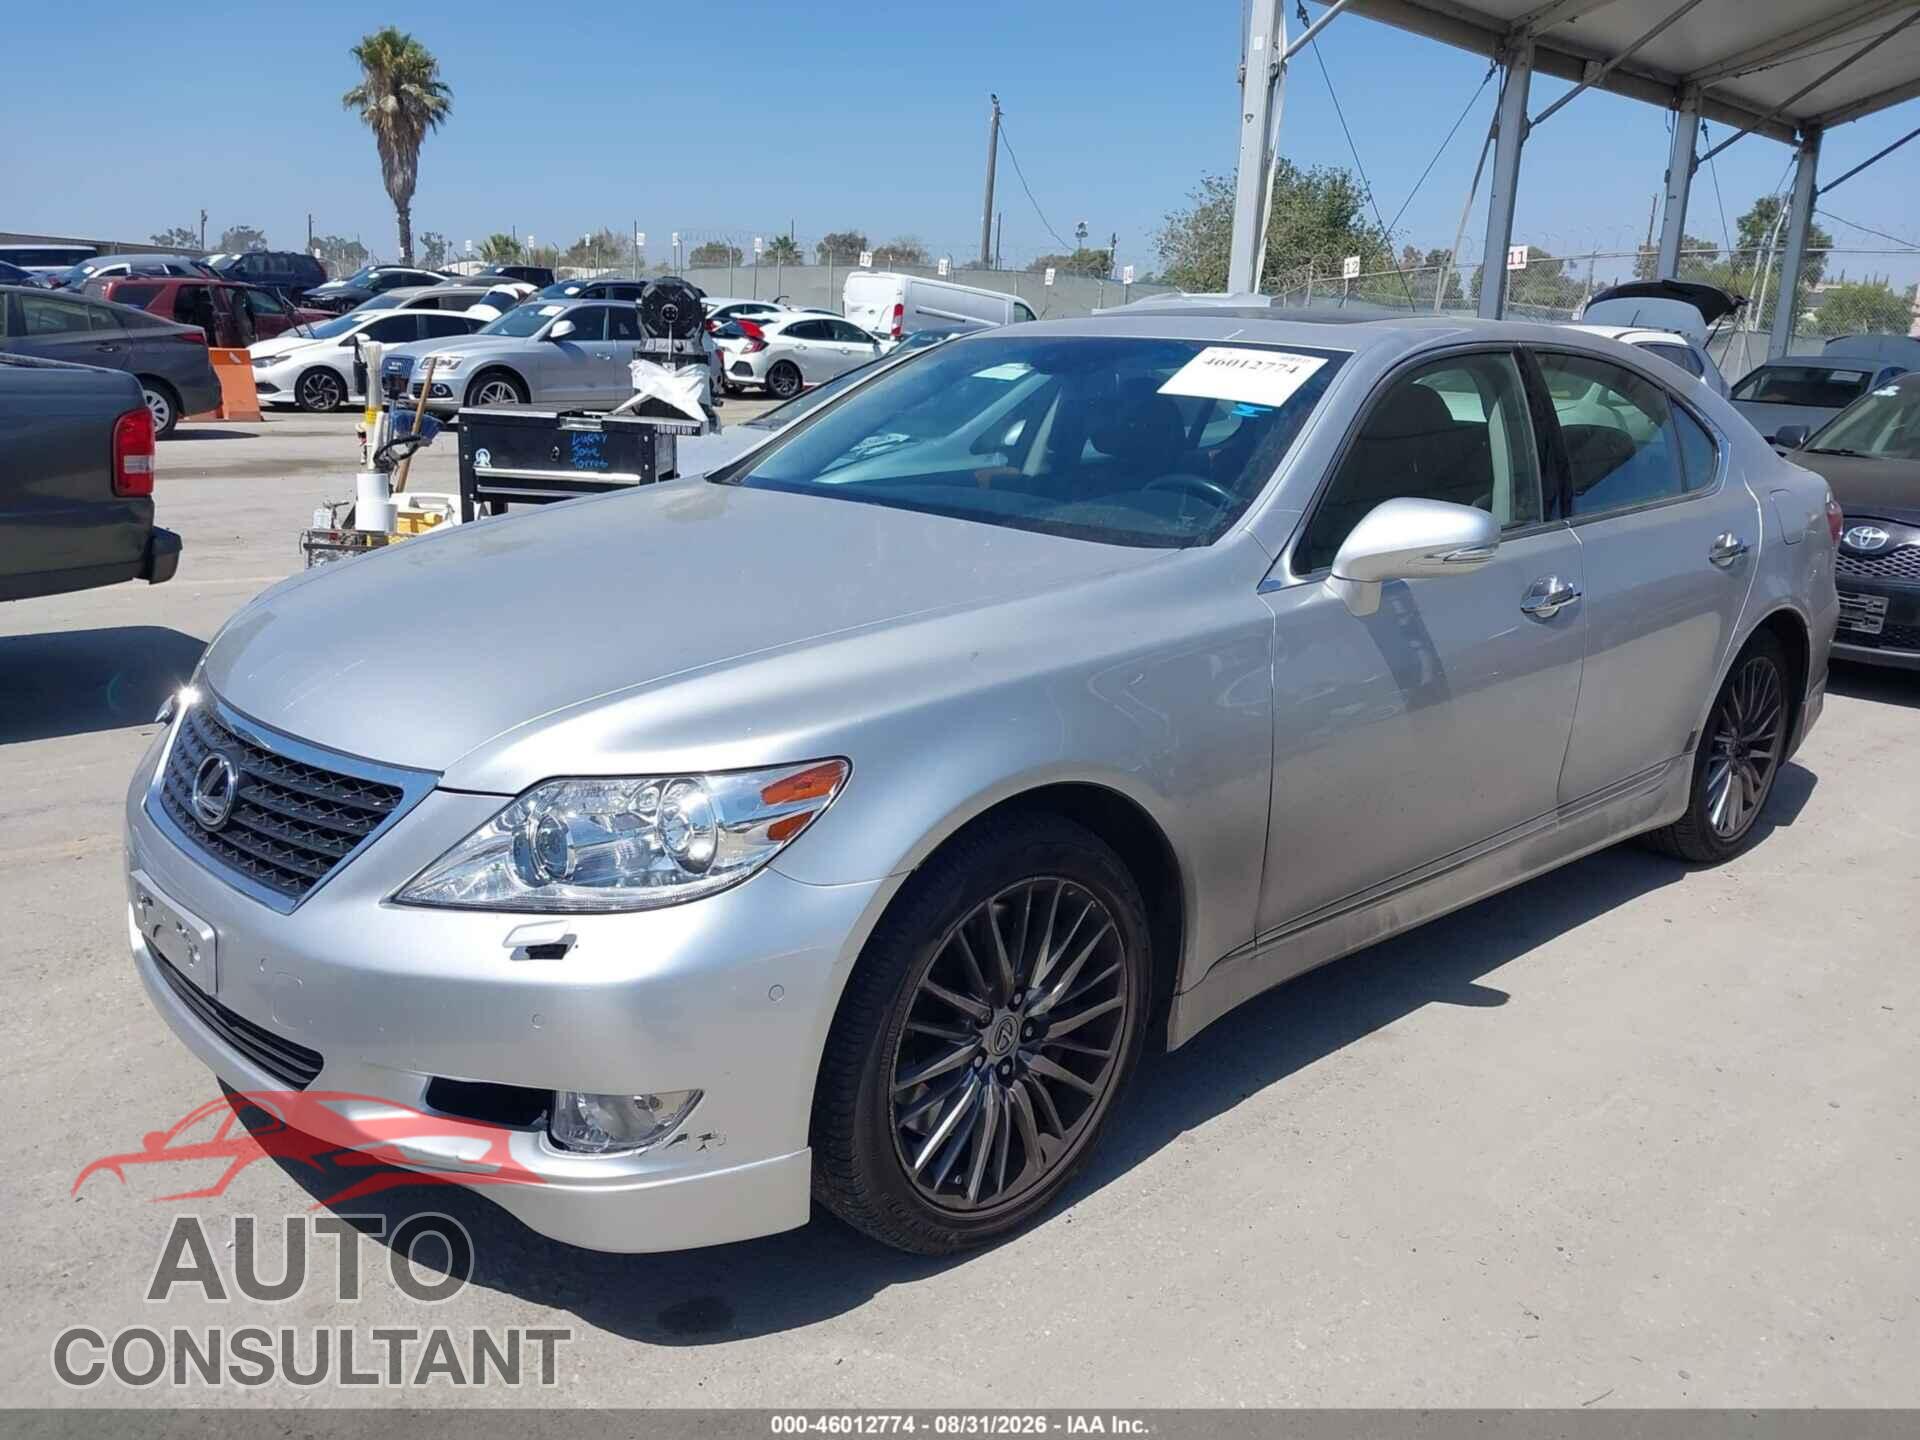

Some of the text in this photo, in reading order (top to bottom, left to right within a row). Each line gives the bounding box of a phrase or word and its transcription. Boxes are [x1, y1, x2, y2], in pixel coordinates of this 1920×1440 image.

[1509, 251, 1525, 265] 11
[1345, 260, 1359, 274] 12
[1203, 358, 1299, 375] 46012774
